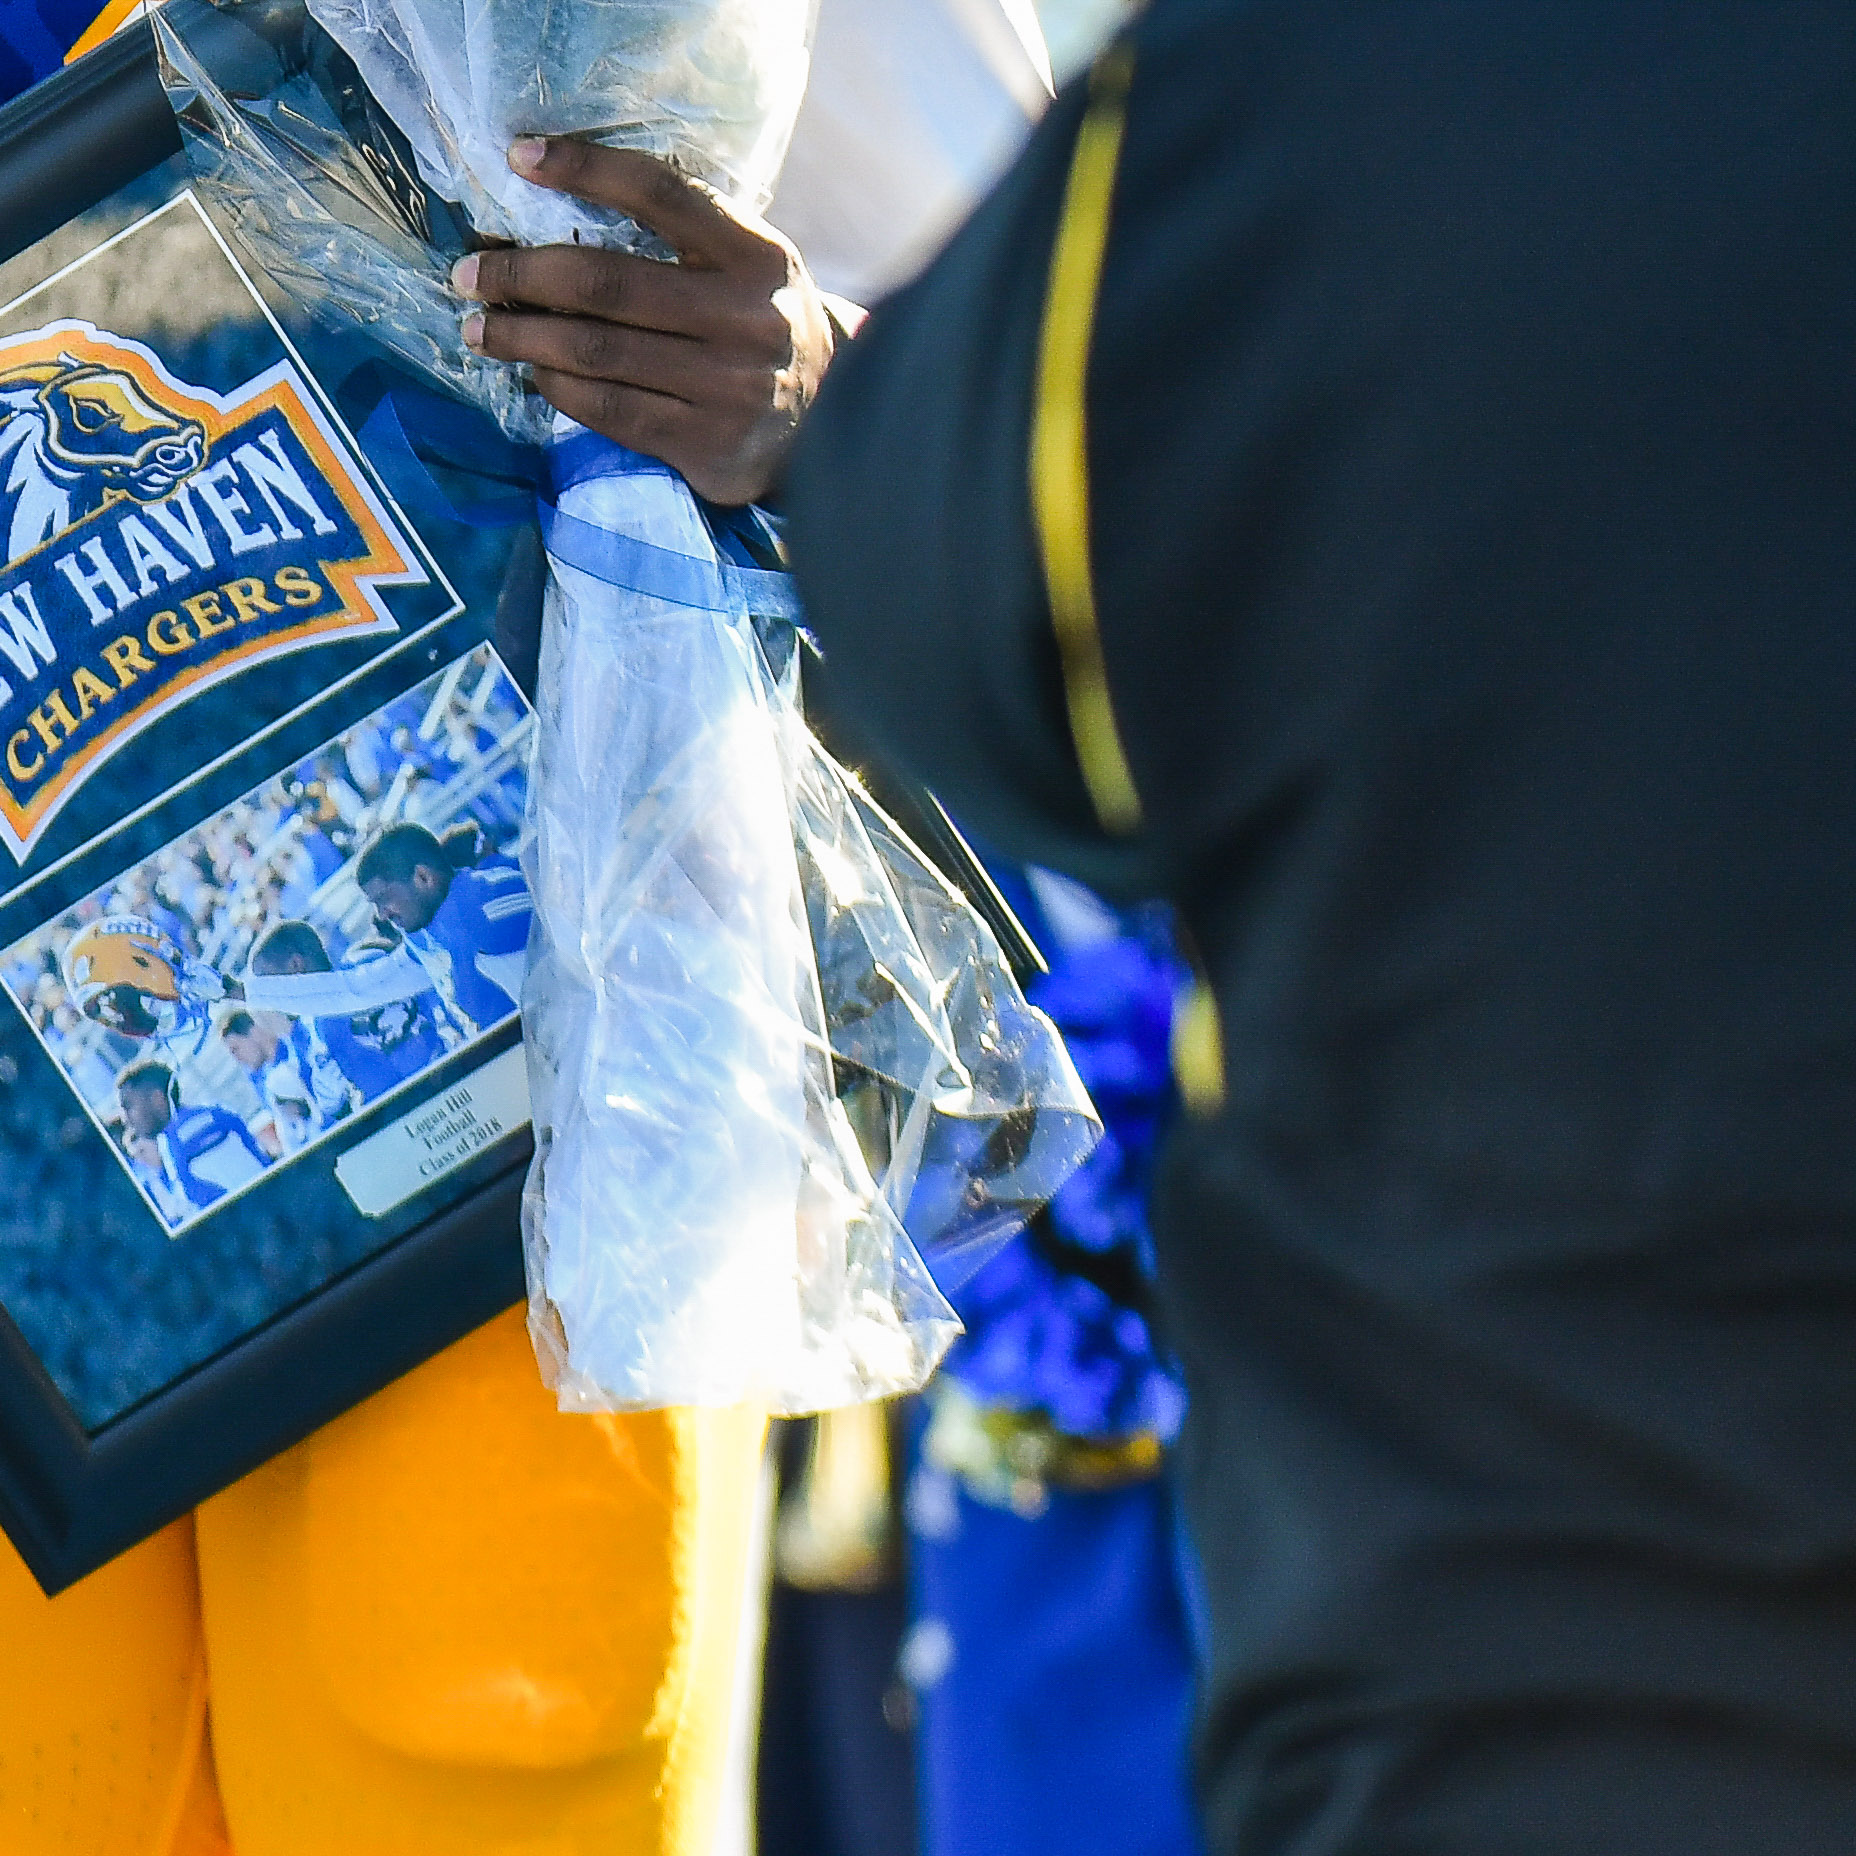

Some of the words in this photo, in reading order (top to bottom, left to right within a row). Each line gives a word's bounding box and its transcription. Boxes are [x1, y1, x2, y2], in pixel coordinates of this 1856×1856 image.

[54, 428, 336, 628] HAVEN
[5, 565, 325, 784] CHARGERS
[403, 1107, 447, 1139] Logan
[445, 1087, 473, 1113] Hill
[422, 1109, 478, 1151] Football
[419, 1151, 455, 1176] Class
[455, 1138, 471, 1156] of
[468, 1116, 504, 1148] 2018
